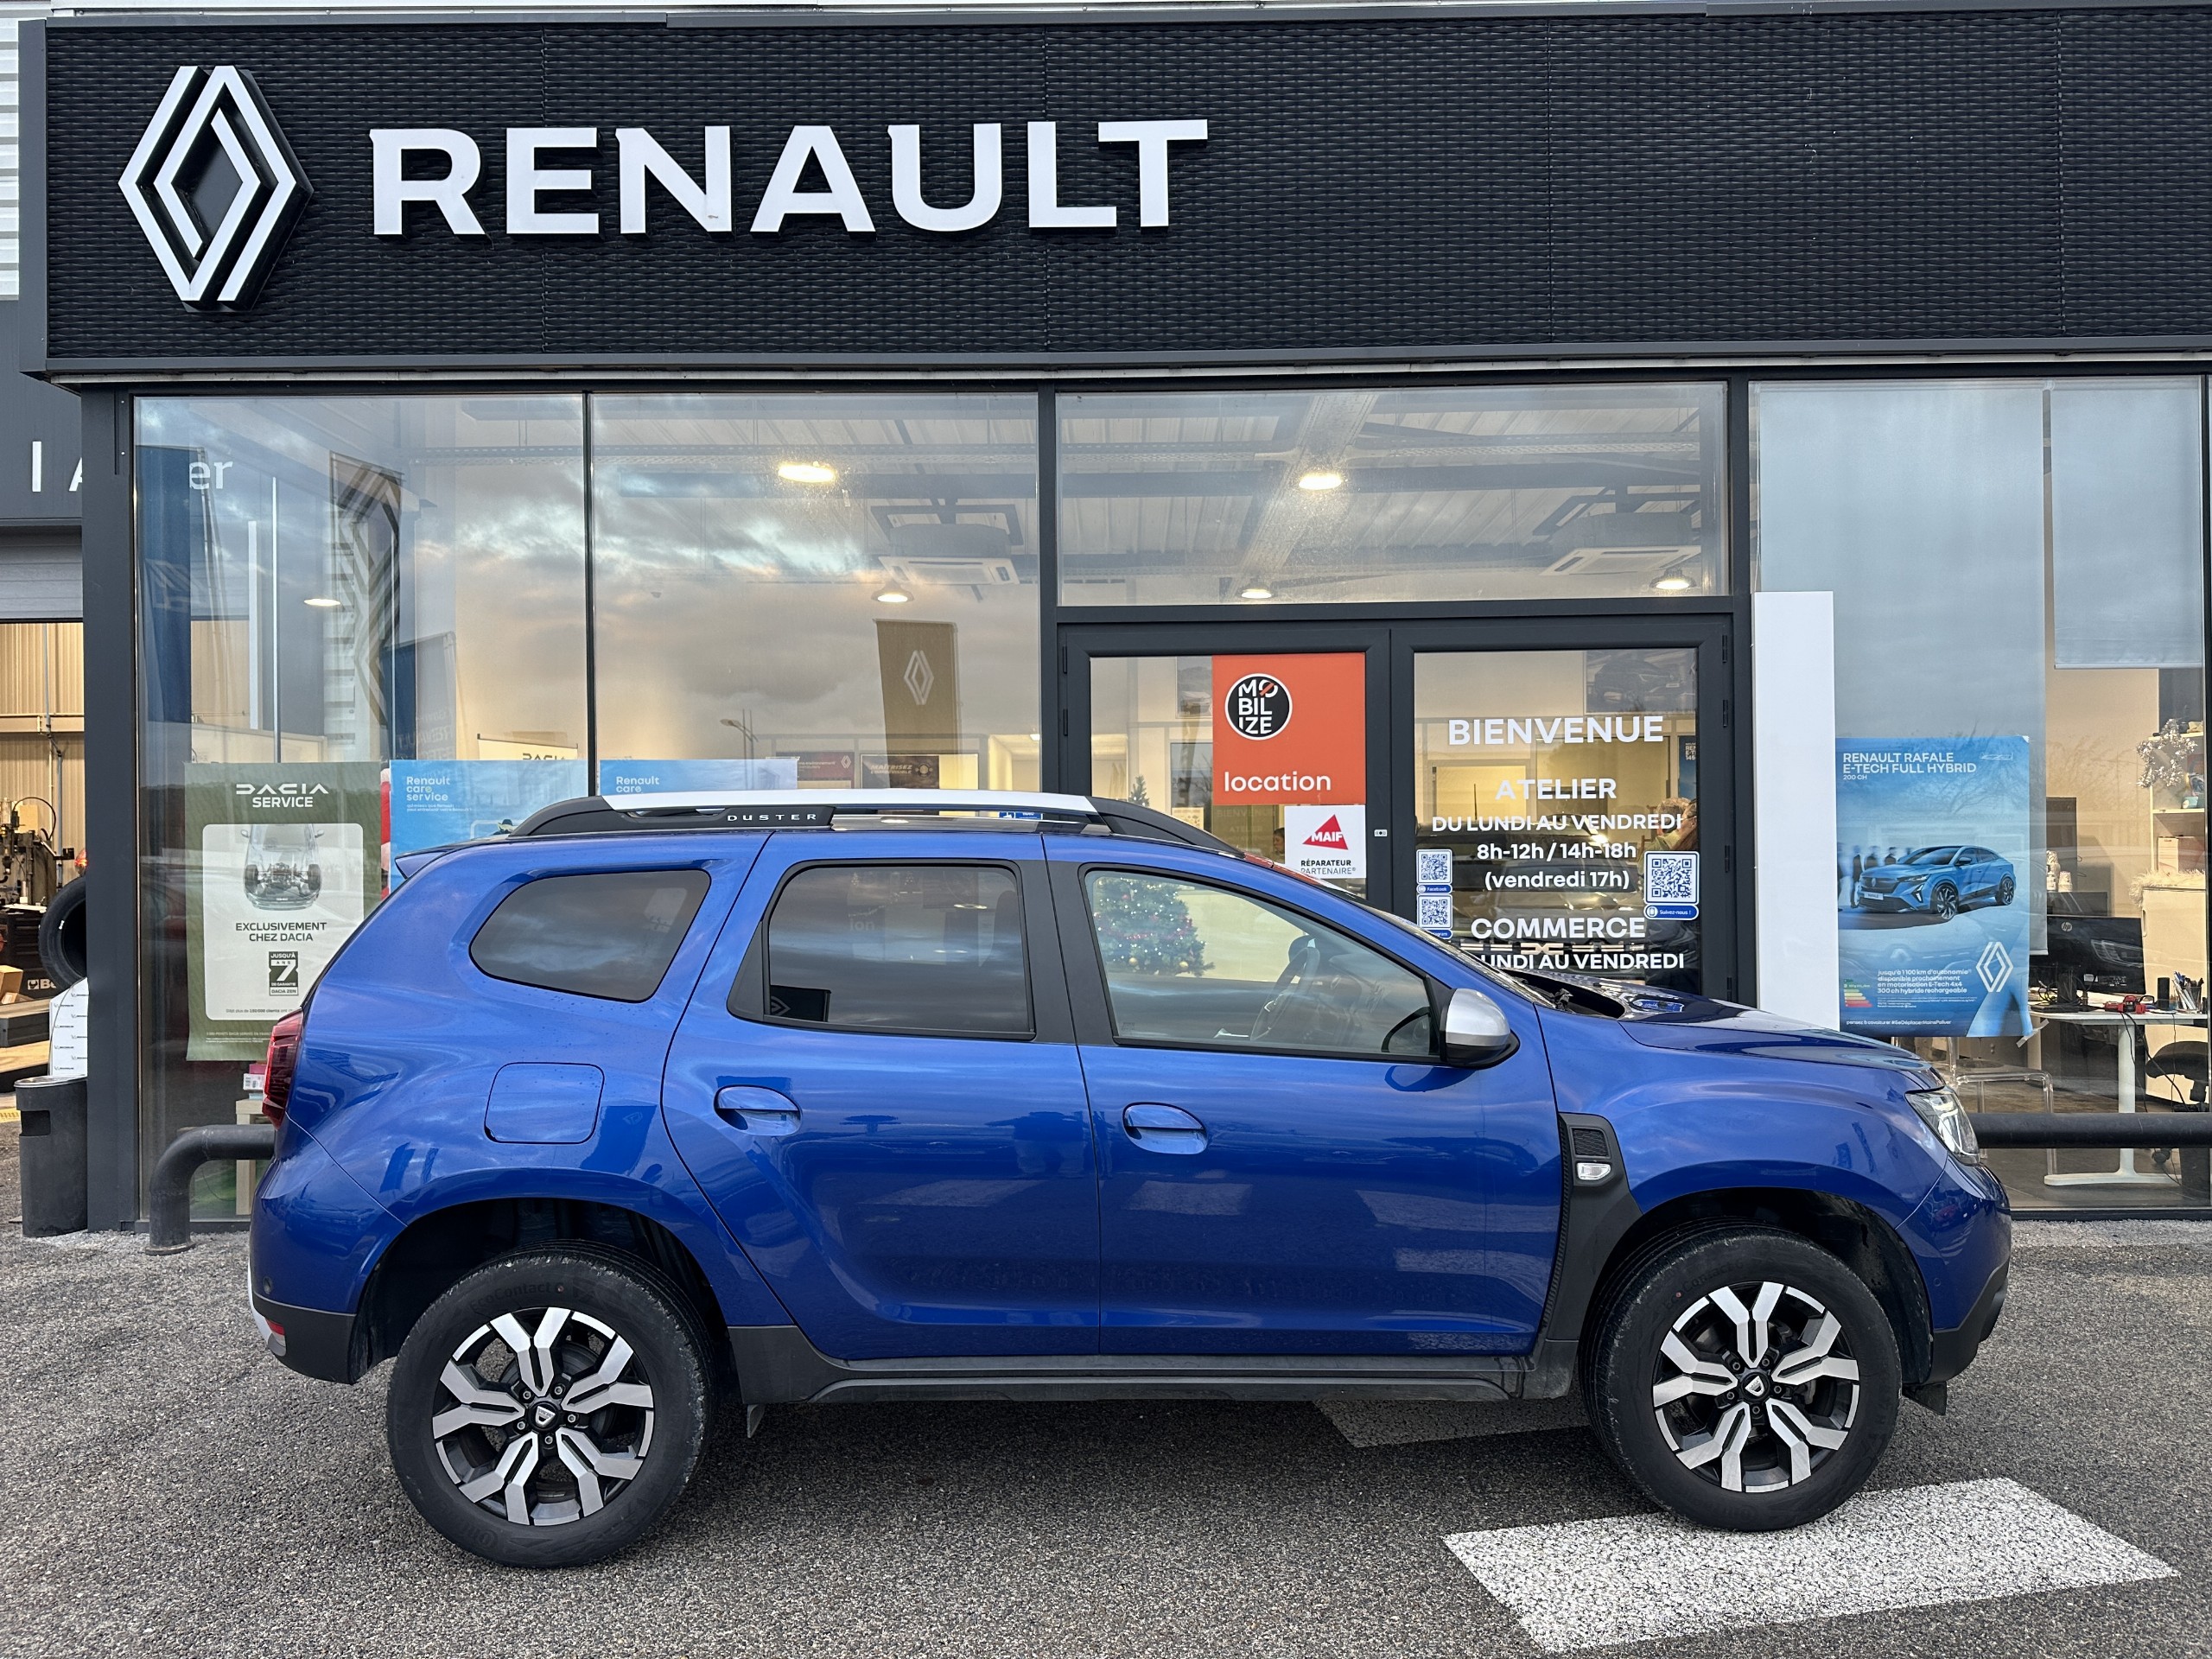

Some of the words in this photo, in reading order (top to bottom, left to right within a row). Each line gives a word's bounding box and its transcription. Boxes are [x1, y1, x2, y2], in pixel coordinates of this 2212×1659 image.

[370, 118, 1208, 236] RENAULT
[1448, 715, 1663, 746] BIENVENUE
[1843, 753, 1901, 763] RENAULT
[1904, 753, 1954, 762] RAFALE
[1843, 764, 1889, 773] E-TECH
[1892, 764, 1924, 773] FULL
[1927, 763, 1976, 773] HYBRID
[406, 777, 450, 785] Renault
[616, 776, 659, 785] Renault
[1224, 771, 1332, 792] location
[236, 783, 329, 795] DACIA
[616, 785, 641, 793] care
[1495, 779, 1617, 799] ATELIER
[252, 797, 314, 808] SERVICE
[406, 792, 448, 801] service
[1432, 817, 1462, 832] DU
[1467, 816, 1531, 831] LUNDI
[1535, 815, 1567, 831] AU
[1570, 813, 1681, 830] VENDREDI
[1311, 831, 1344, 842] MAIF
[1477, 842, 1544, 860] 8h-12h
[1560, 842, 1637, 859] 14h-18h
[1484, 871, 1586, 892] (vendredi
[1589, 870, 1630, 890] 17h)
[235, 922, 327, 931] EXCLUSIVEMENT
[1471, 917, 1646, 939] COMMERCE
[249, 933, 277, 942] CHEZ
[280, 933, 314, 942] DACIA
[1481, 954, 1535, 969] UNDI
[1538, 954, 1569, 969] AU
[1573, 953, 1684, 969] VENDREDI
[270, 959, 296, 982] 7
